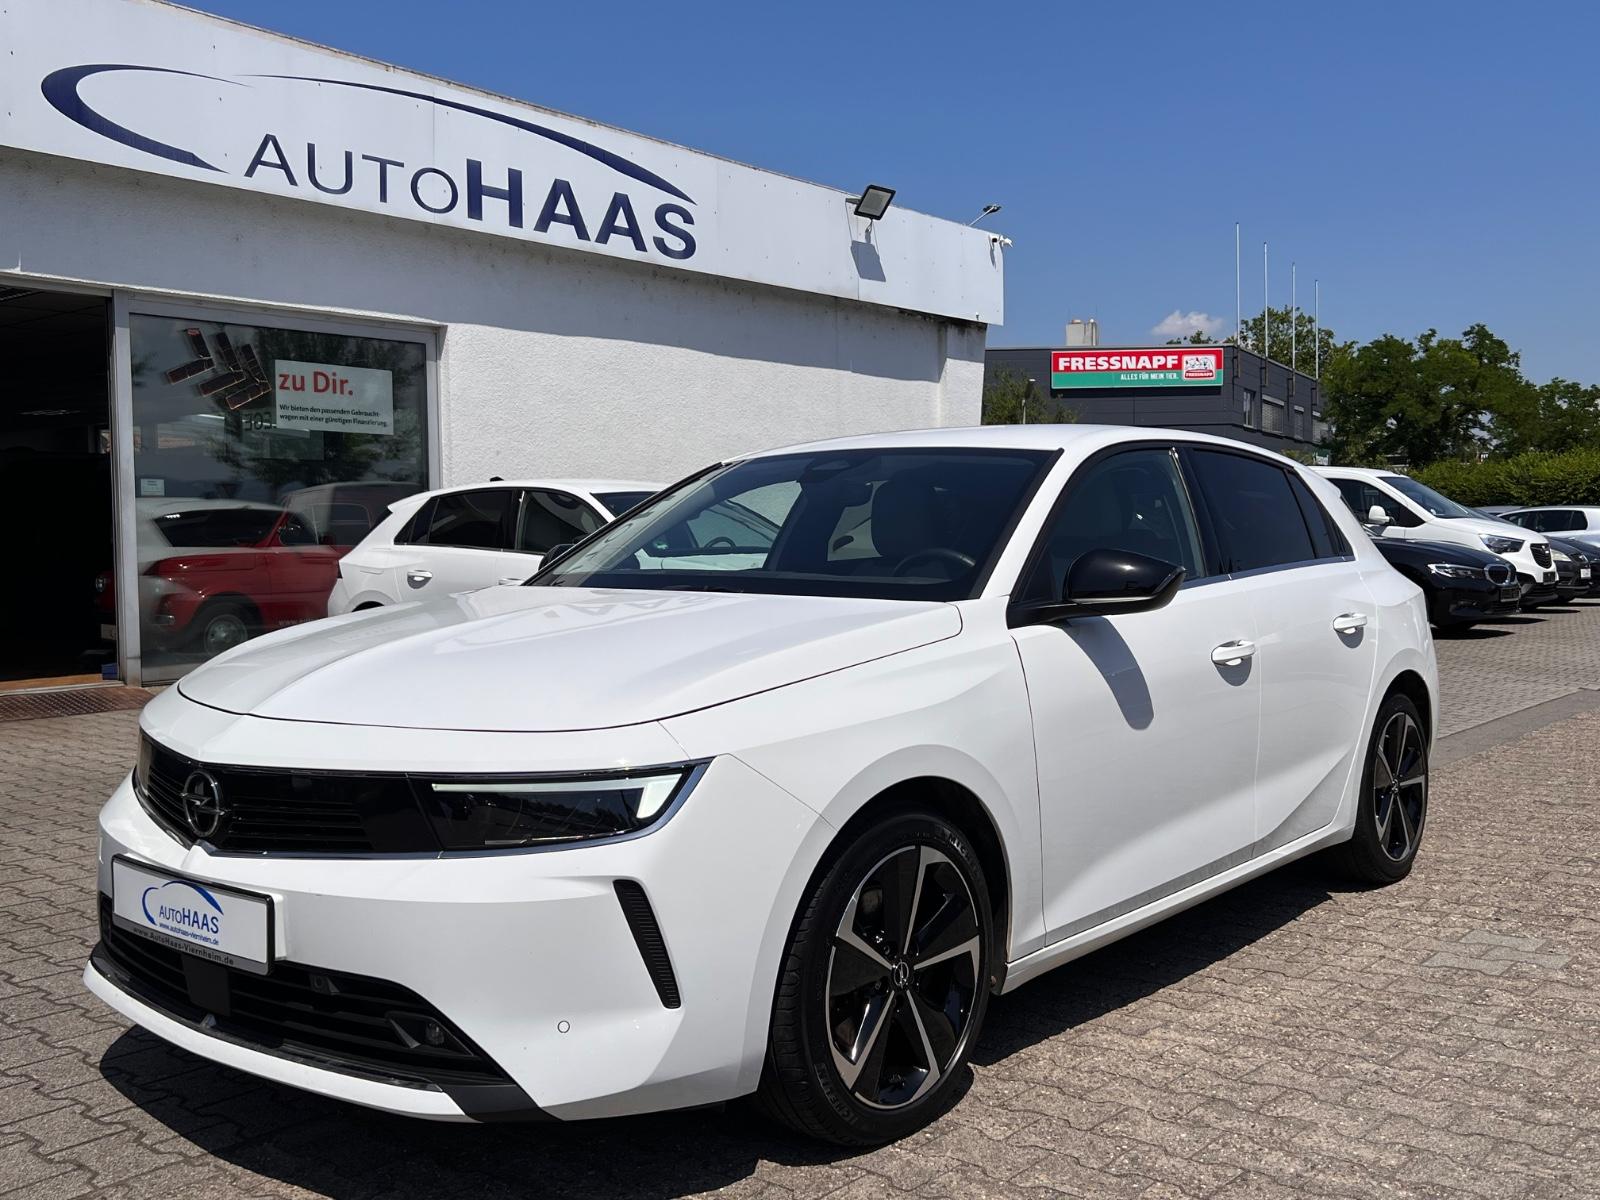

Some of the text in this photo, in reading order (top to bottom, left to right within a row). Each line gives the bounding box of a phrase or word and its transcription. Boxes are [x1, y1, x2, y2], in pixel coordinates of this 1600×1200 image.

[1058, 355, 1179, 370] FRESSNAPF
[1139, 372, 1149, 380] FÜR
[279, 371, 354, 396] zu Dir.
[321, 407, 350, 415] passenden
[325, 416, 352, 424] günstigen
